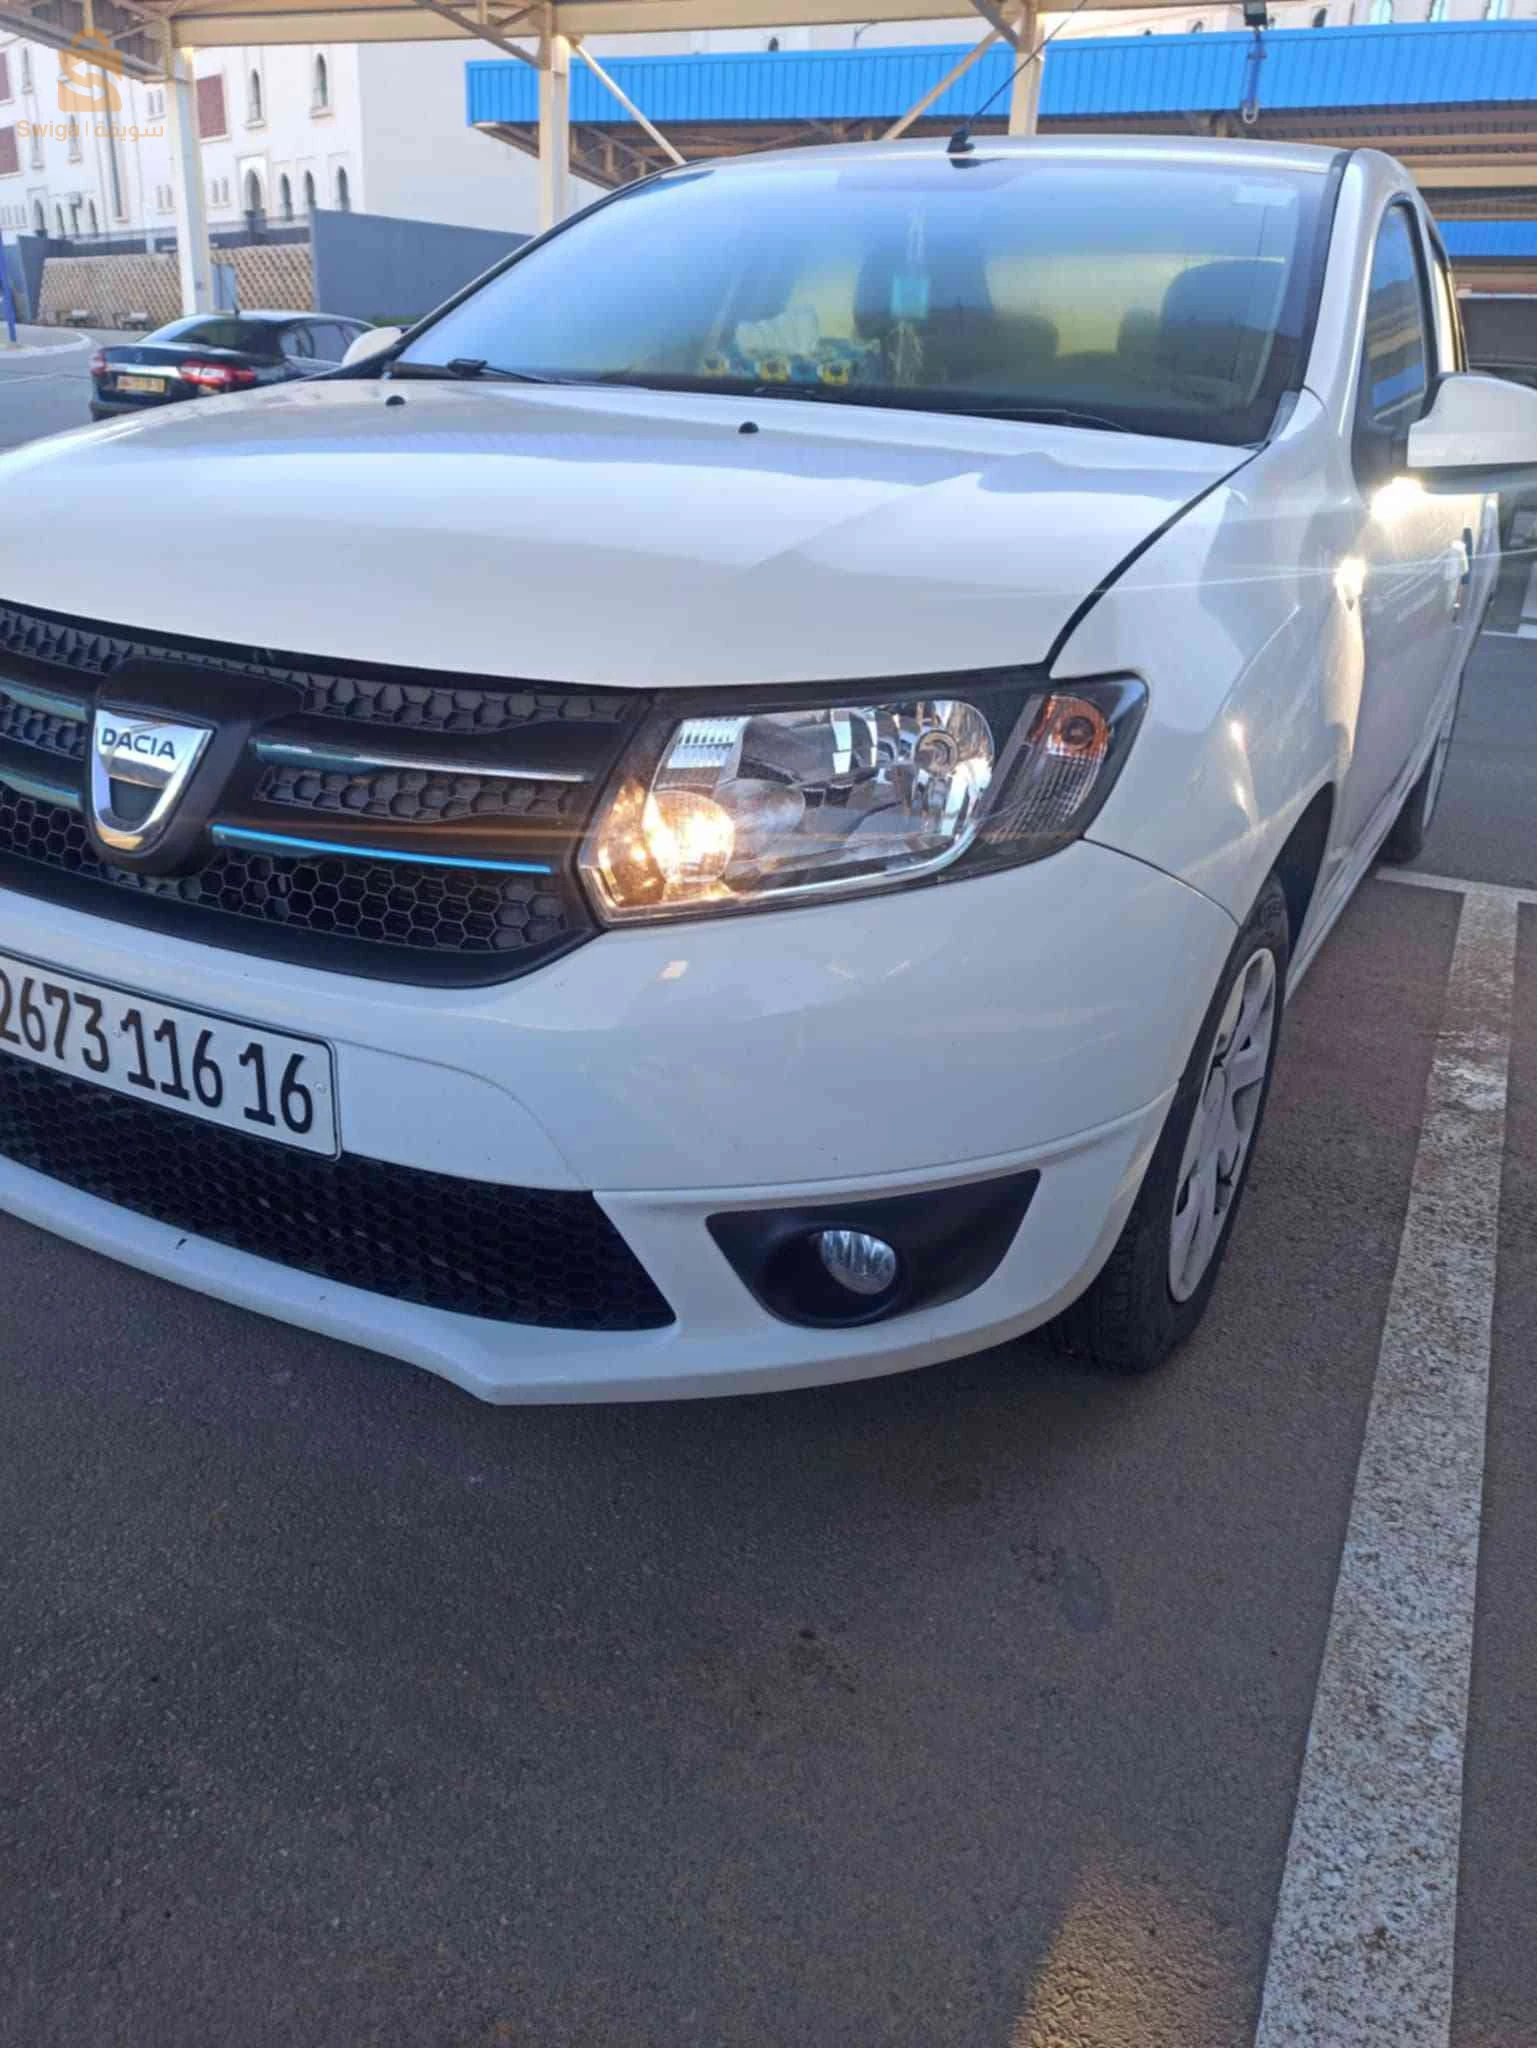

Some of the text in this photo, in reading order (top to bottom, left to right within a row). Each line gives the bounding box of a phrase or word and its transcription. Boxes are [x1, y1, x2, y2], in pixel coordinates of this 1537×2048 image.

[101, 727, 176, 760] DACIA
[120, 1008, 224, 1109] 116
[238, 1041, 314, 1134] 16
